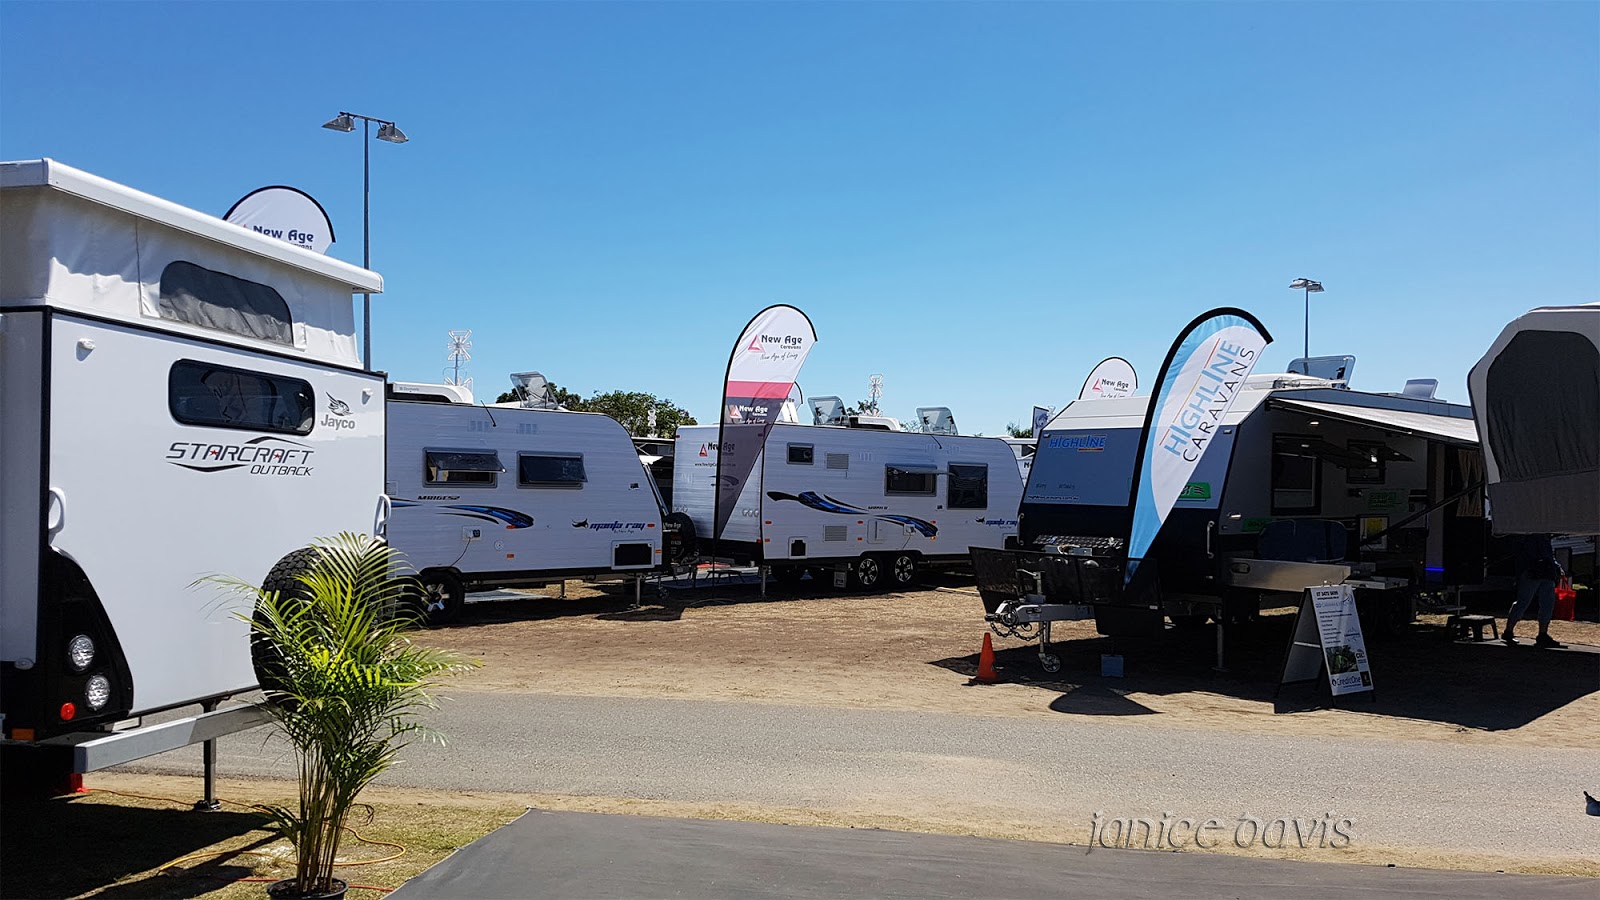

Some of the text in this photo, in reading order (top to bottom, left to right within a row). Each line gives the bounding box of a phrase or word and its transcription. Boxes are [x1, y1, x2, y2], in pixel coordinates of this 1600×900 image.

[253, 225, 314, 243] New Age
[761, 334, 803, 346] New Age
[1101, 378, 1129, 389] New Age
[1164, 340, 1241, 456] HIGHLINE
[1183, 347, 1255, 462] CARAVANS
[739, 404, 769, 414] New Age
[321, 414, 355, 430] Jayco
[1049, 435, 1106, 448] HIGHLINE
[165, 442, 314, 465] STARCRAFT
[250, 464, 314, 477] OUTBACK
[589, 520, 646, 531] manta ray
